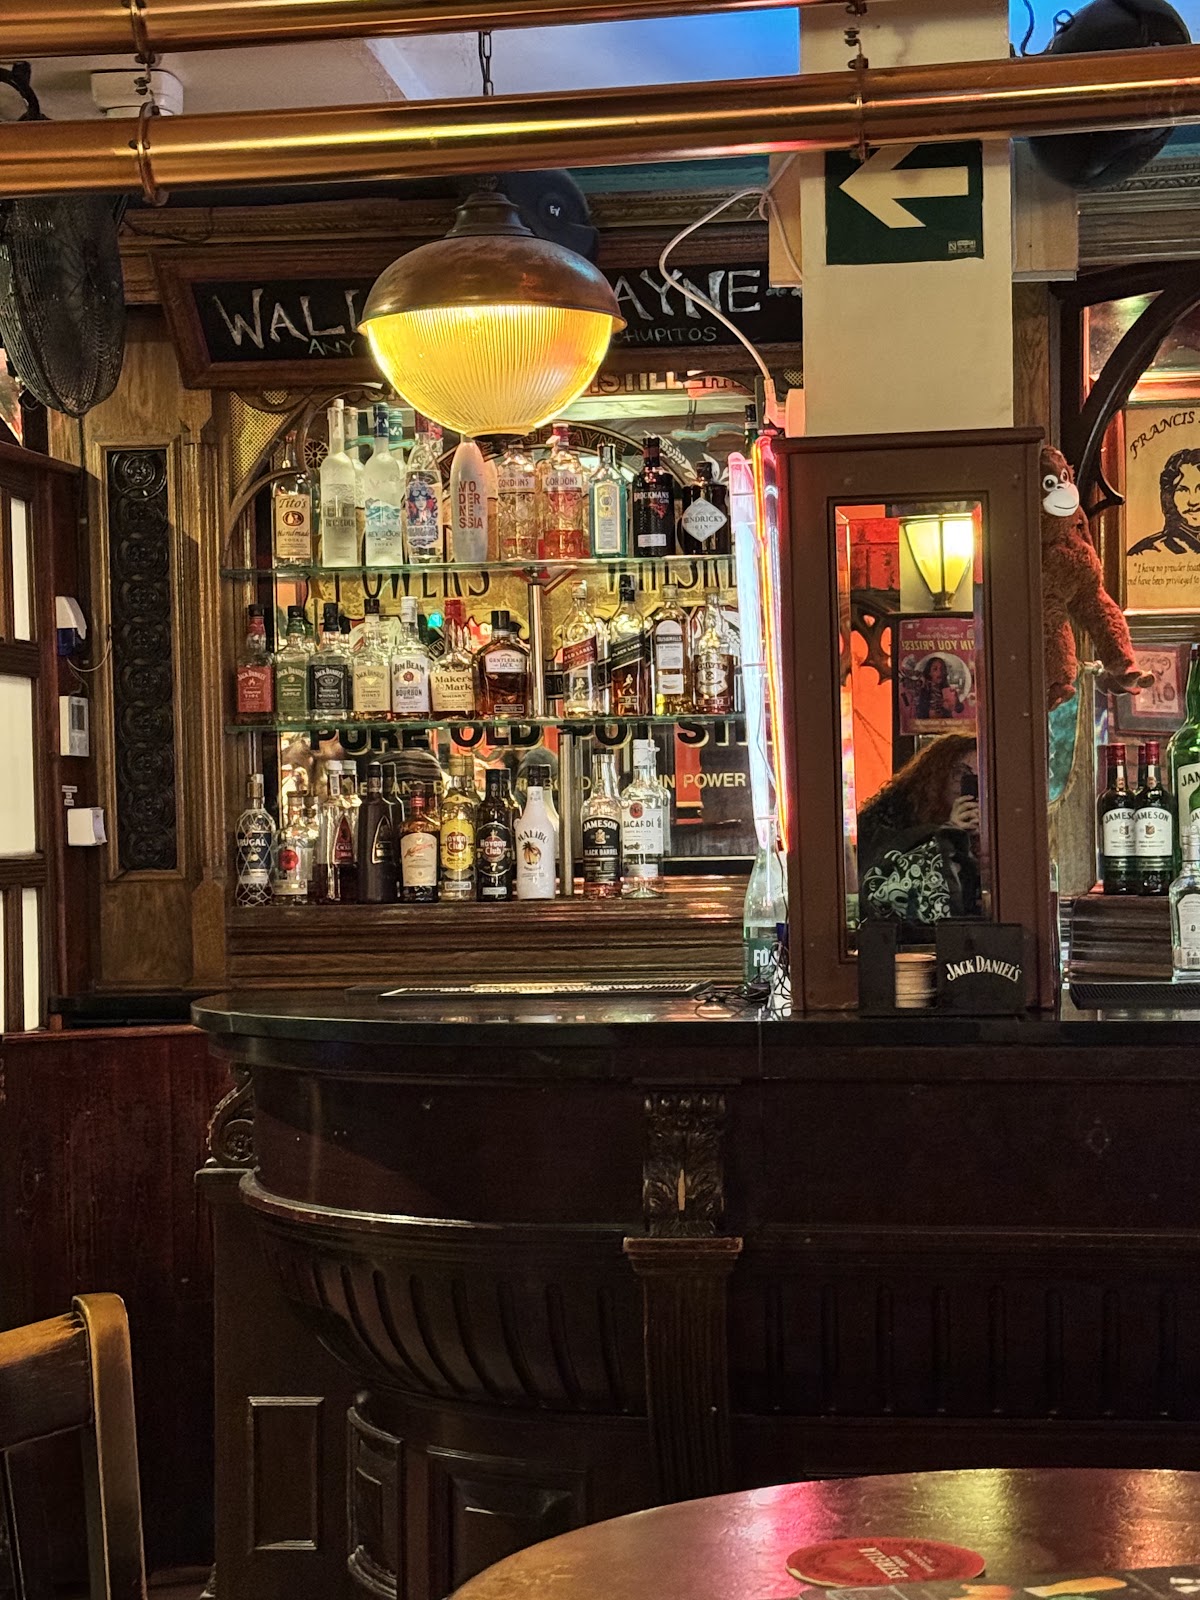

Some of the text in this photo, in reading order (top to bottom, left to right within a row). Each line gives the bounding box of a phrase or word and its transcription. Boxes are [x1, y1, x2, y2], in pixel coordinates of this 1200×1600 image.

[612, 268, 761, 321] AYNE
[309, 338, 355, 355] ANY
[1129, 411, 1195, 460] FRANCIS
[278, 498, 307, 509] Tito's
[458, 493, 480, 504] DER
[459, 517, 484, 529] SSIA
[575, 645, 594, 657] LABEL
[393, 660, 425, 676] JIM BEAM
[435, 674, 474, 684] Maker's
[395, 689, 422, 697] BOURBON
[445, 683, 472, 691] Mark
[450, 724, 542, 747] OLD
[683, 773, 746, 788] POWER
[583, 820, 618, 833] JAMESON
[480, 839, 507, 847] Havana
[490, 862, 497, 872] 7
[945, 955, 1023, 983] JACK DANIEL'S
